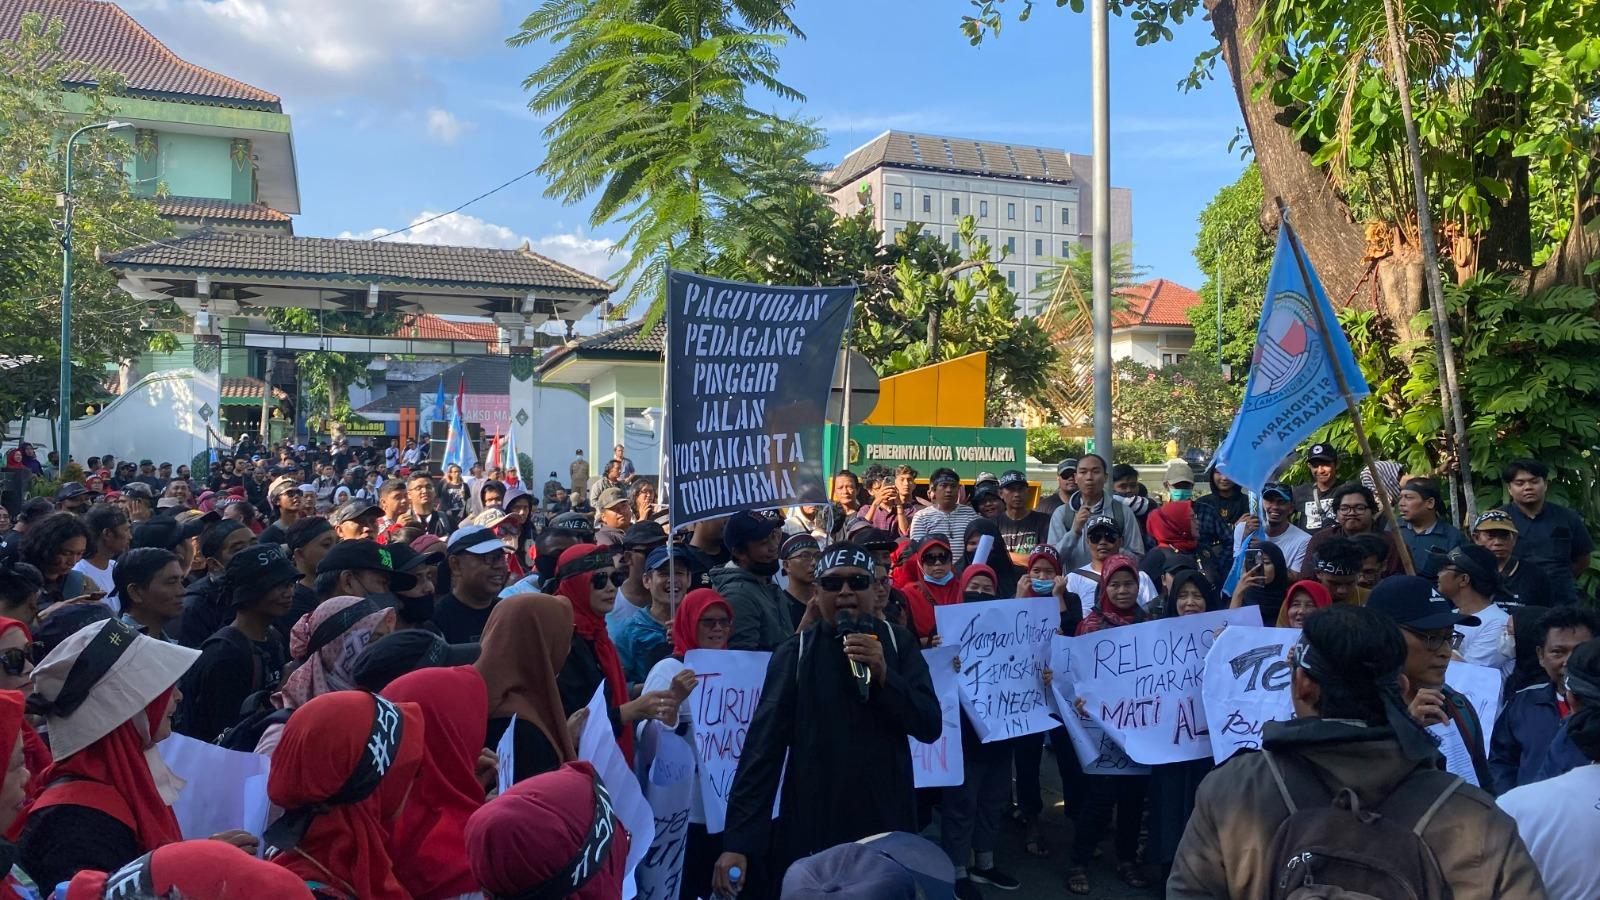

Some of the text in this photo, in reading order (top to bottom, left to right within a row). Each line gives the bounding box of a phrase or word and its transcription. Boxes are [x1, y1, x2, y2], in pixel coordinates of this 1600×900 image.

[683, 283, 828, 322] PAGUYUBAN
[684, 323, 806, 357] PEDAGANG
[693, 363, 779, 395] PINGGIR
[696, 399, 766, 433] JALAN
[674, 432, 805, 477] YOGYAKARTA
[866, 444, 1015, 462] PEMERINTAH KOTA YOGYAKARTA
[679, 469, 797, 515] TRIDHARMA
